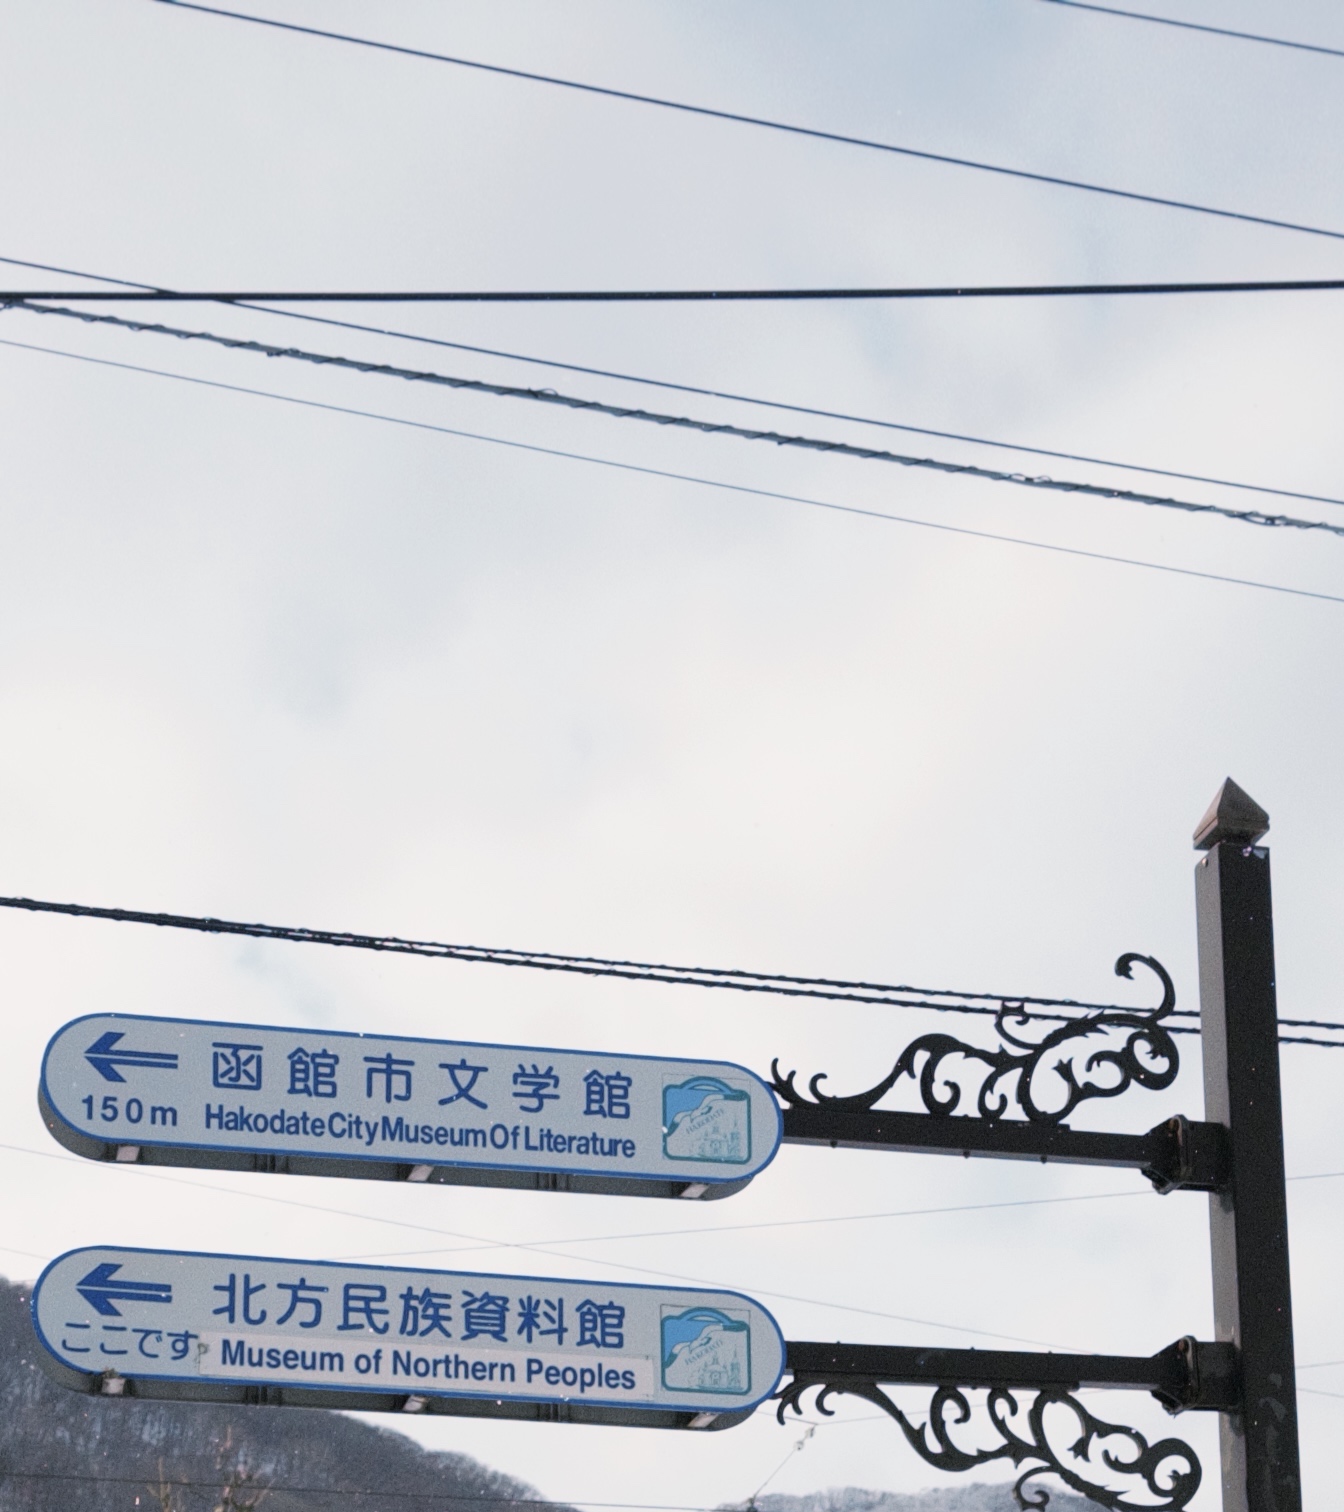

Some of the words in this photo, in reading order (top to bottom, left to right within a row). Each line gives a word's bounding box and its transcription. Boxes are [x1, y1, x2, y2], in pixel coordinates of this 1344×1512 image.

[211, 1041, 633, 1120] 函館市文学館
[81, 1094, 178, 1127] 150m
[205, 1103, 326, 1137] Hakodate
[327, 1111, 379, 1147] City
[381, 1115, 487, 1149] Museum
[489, 1123, 520, 1150] Of
[524, 1125, 636, 1159] Literature
[212, 1273, 625, 1349] 北方民族資料館
[61, 1322, 199, 1361] ここです
[221, 1338, 344, 1373] Museum
[354, 1348, 382, 1375] of
[392, 1349, 516, 1383] Northern
[526, 1358, 636, 1394] Peoples
